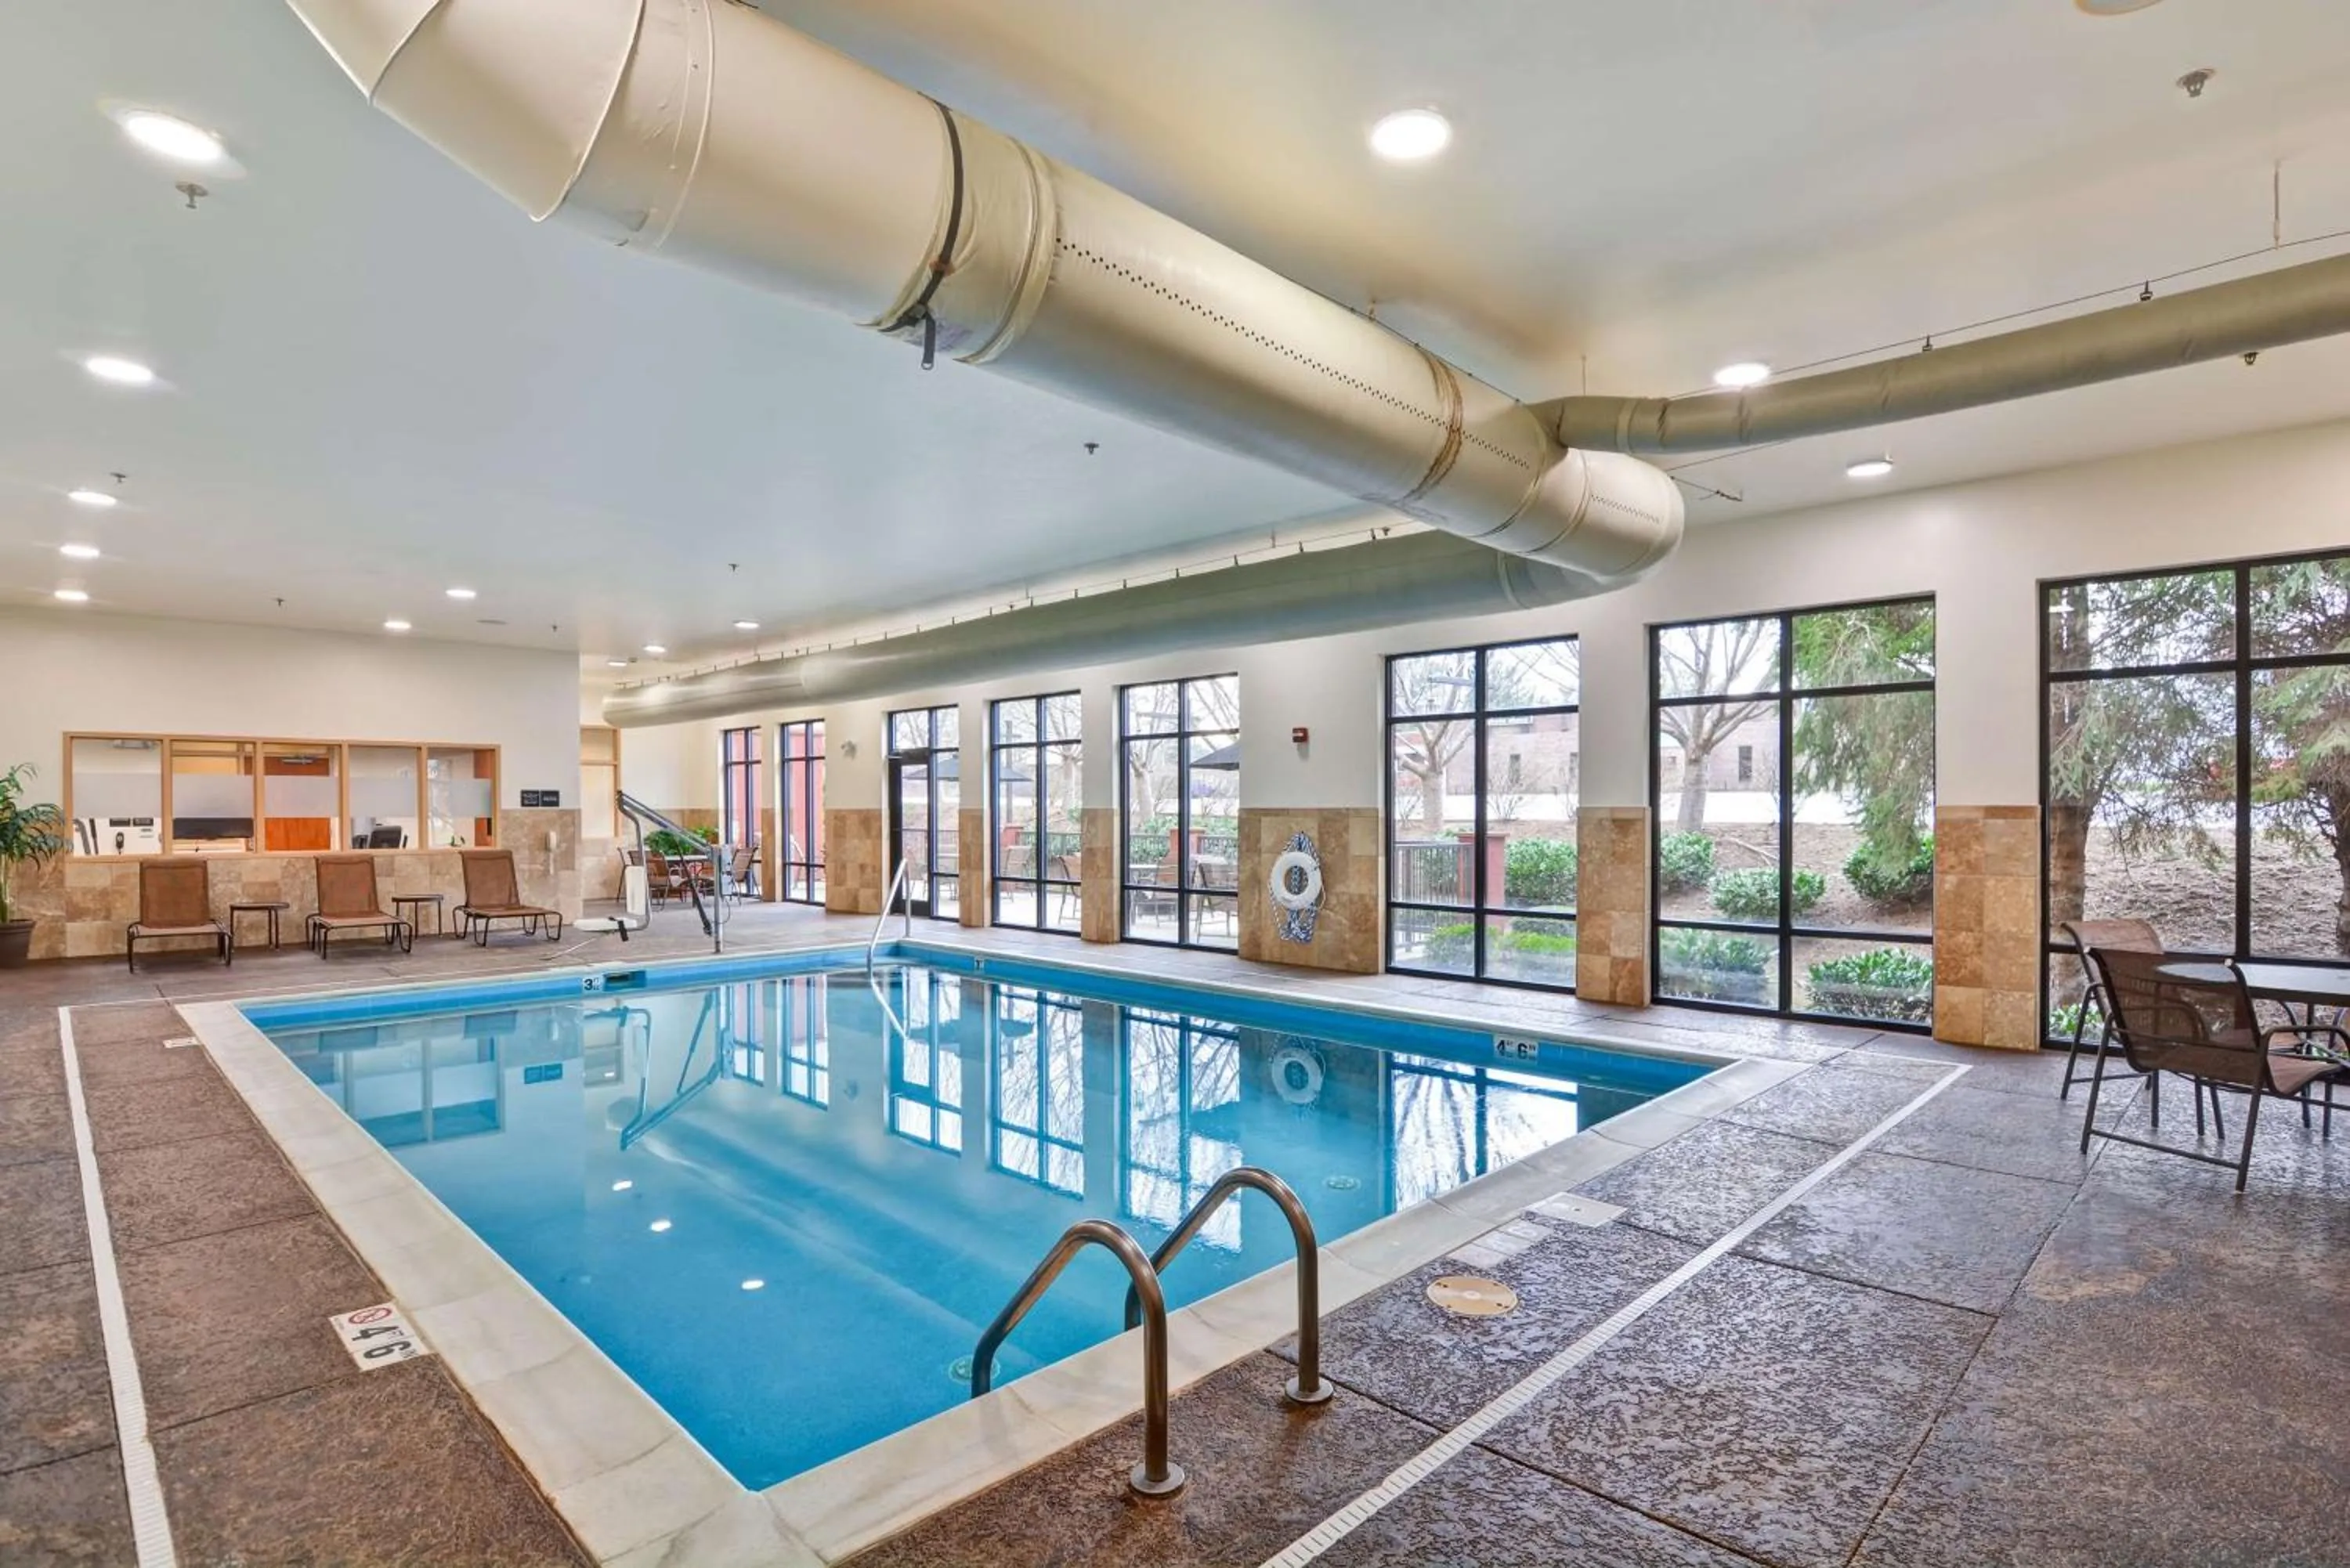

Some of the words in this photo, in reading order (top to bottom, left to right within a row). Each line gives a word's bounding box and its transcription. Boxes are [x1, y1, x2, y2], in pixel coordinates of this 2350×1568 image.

[584, 978, 593, 991] 3
[351, 1326, 399, 1342] 4
[363, 1341, 411, 1359] 6
